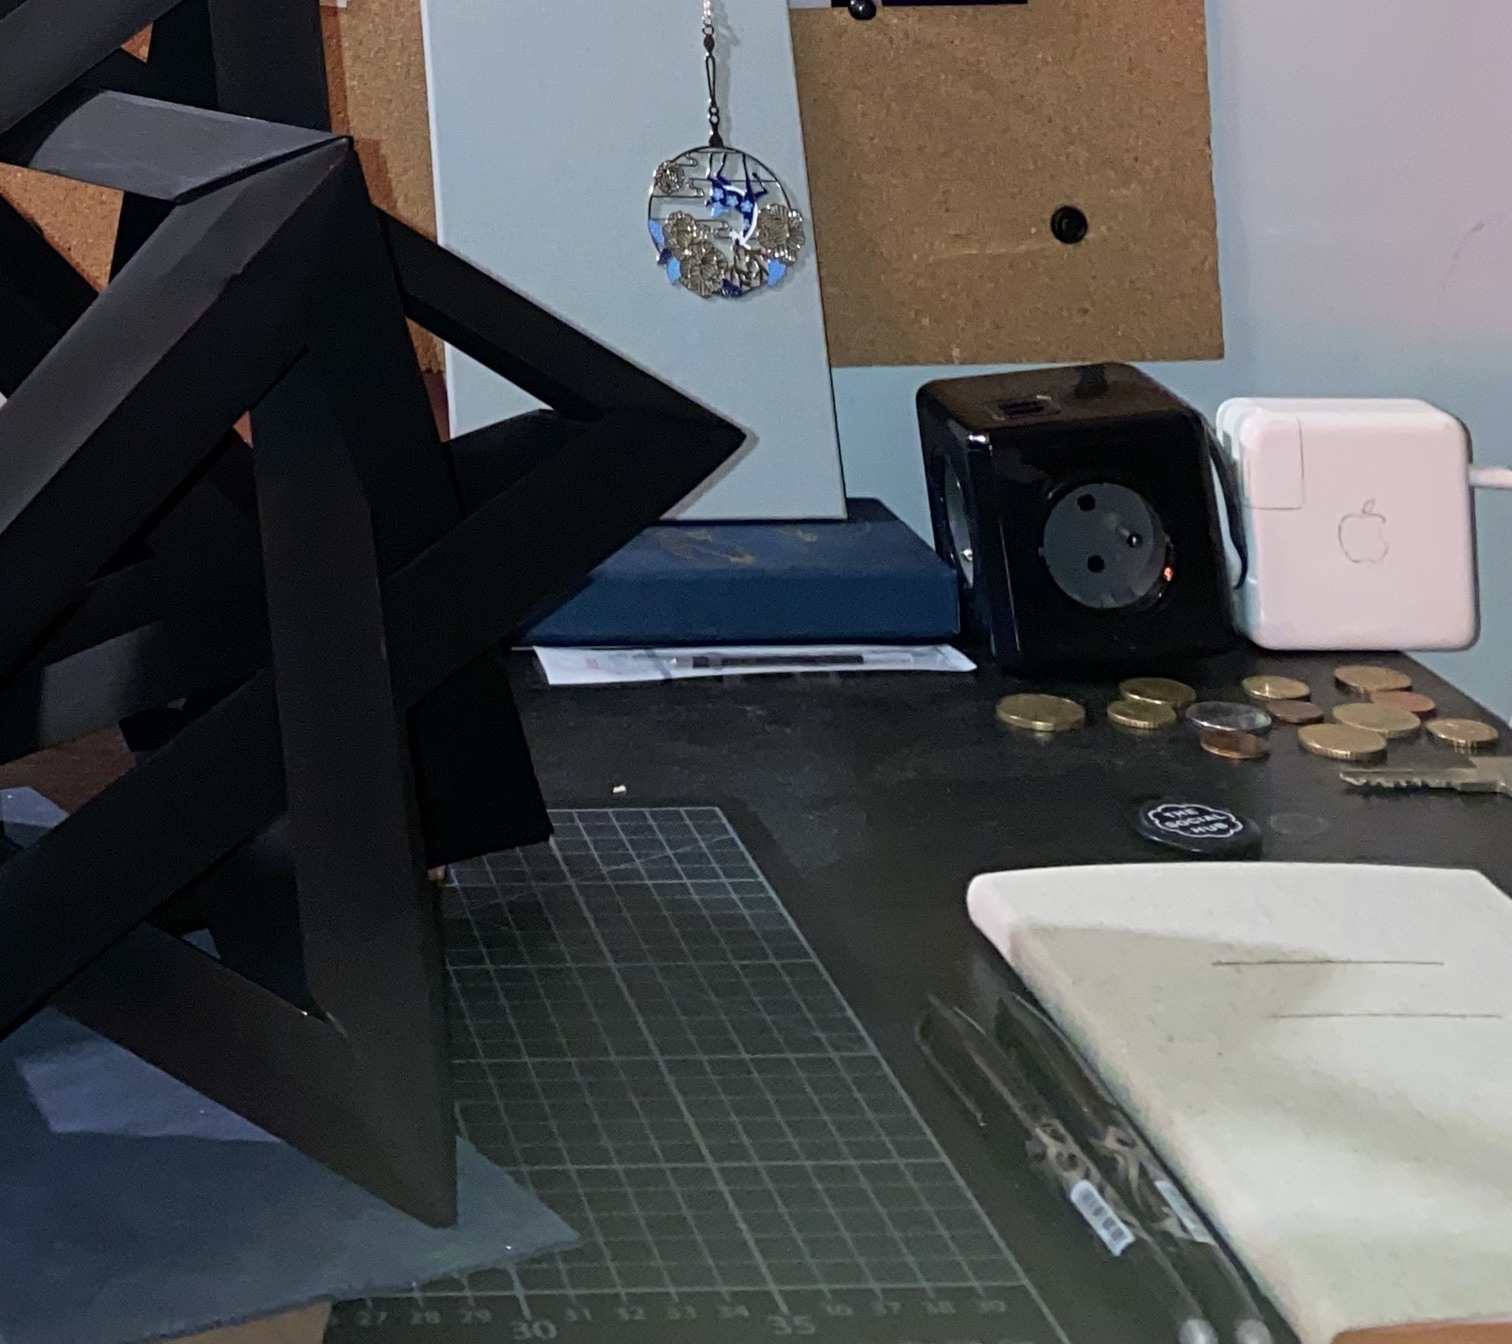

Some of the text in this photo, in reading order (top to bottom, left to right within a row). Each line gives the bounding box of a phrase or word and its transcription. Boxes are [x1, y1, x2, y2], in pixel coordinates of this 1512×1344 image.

[1163, 808, 1199, 818] THE
[1165, 813, 1227, 828] SOCIAL
[1190, 822, 1228, 834] HUB
[512, 1319, 558, 1340] 30
[768, 1314, 816, 1336] 35
